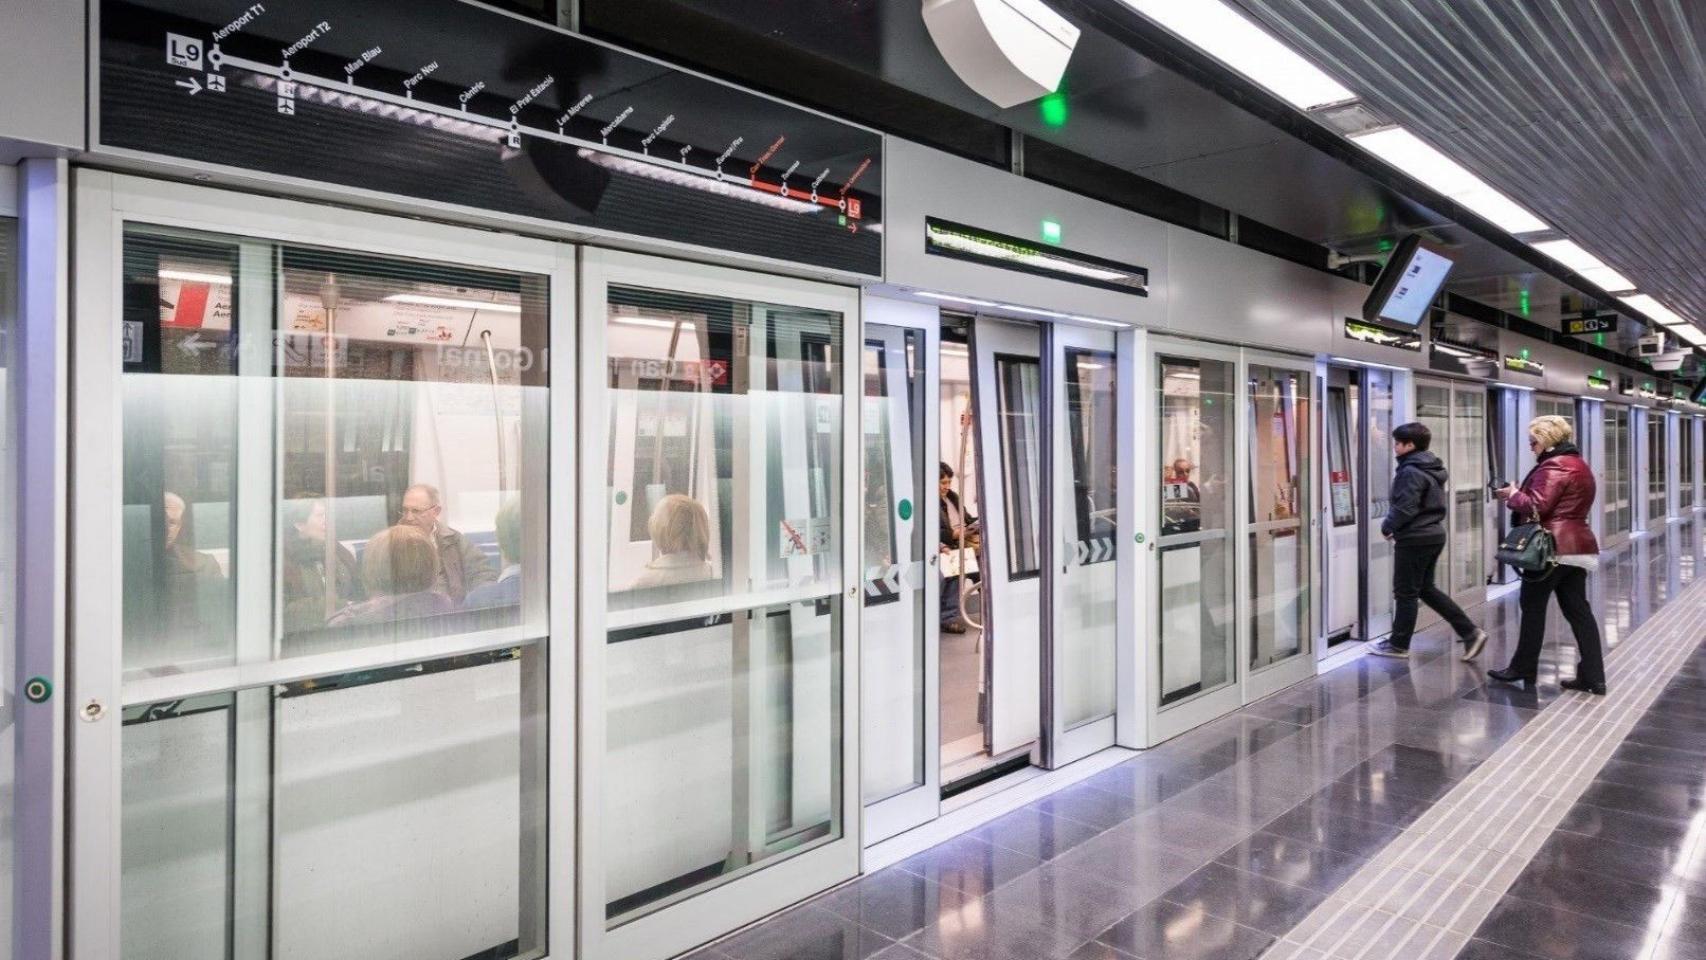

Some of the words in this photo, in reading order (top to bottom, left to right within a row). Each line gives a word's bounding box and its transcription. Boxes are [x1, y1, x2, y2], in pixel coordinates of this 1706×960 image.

[212, 11, 254, 42] Aeroport
[250, 3, 266, 16] T1
[172, 40, 199, 61] L9
[281, 29, 320, 59] Aeroport
[316, 21, 332, 33] T2
[344, 58, 364, 75] Mas
[361, 45, 383, 63] Blau
[403, 73, 423, 89] Parc
[420, 60, 439, 76] Nou
[509, 104, 520, 115] El
